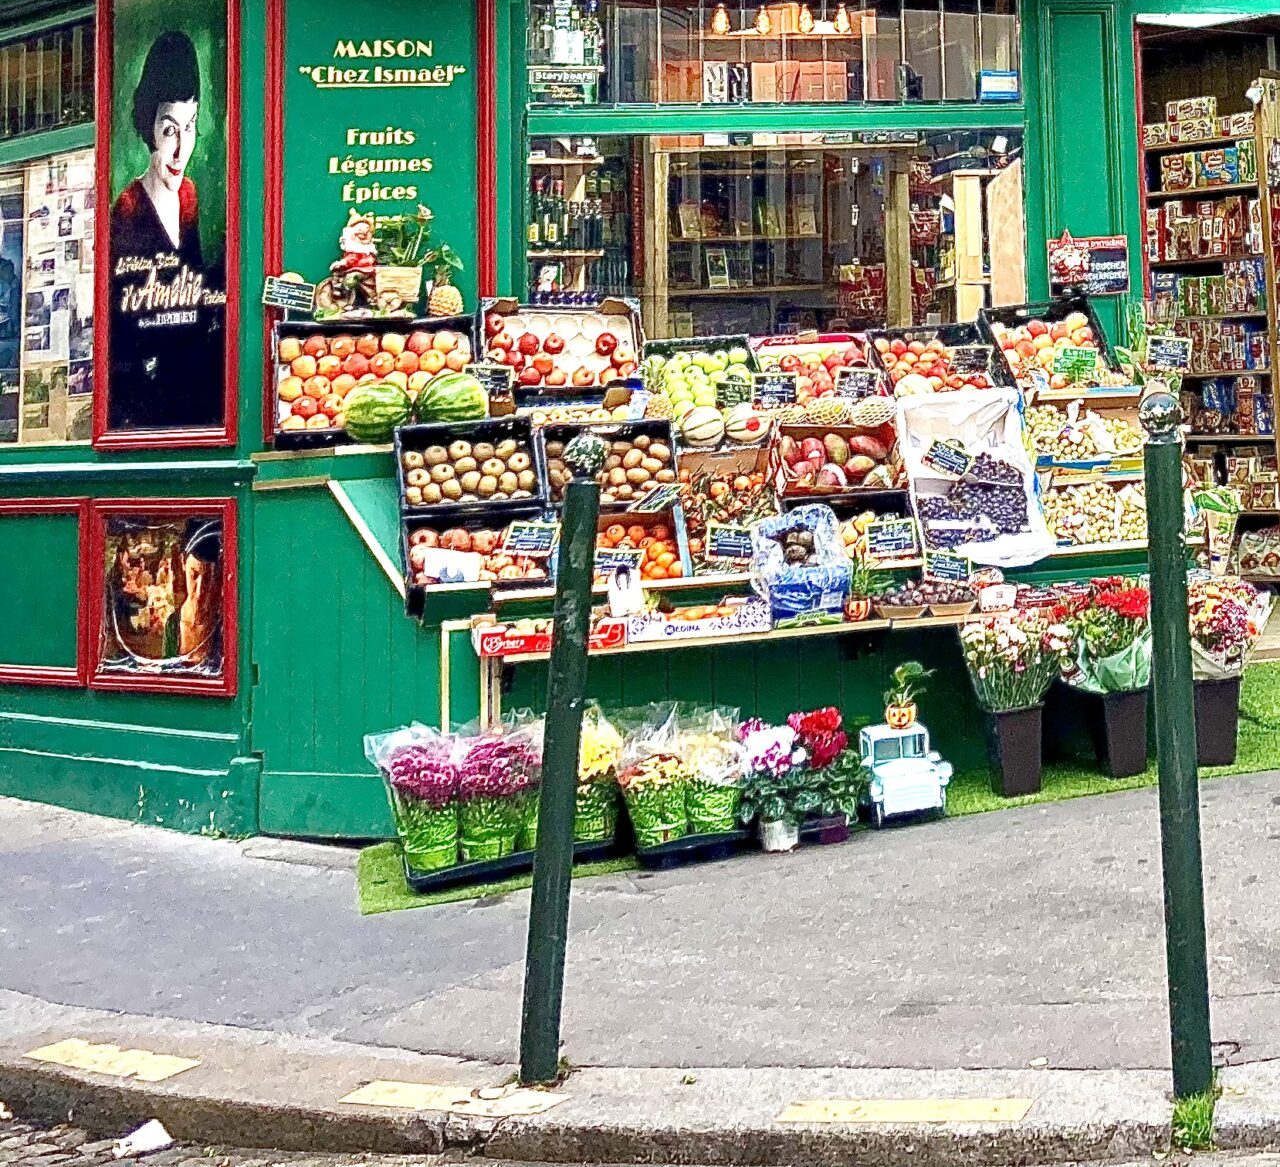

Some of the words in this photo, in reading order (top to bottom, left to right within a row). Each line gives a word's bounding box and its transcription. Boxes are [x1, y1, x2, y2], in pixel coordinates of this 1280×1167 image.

[333, 39, 433, 59] MAISON
[346, 127, 416, 146] Fruits
[328, 155, 433, 177] Légumes
[342, 181, 418, 204] Épices
